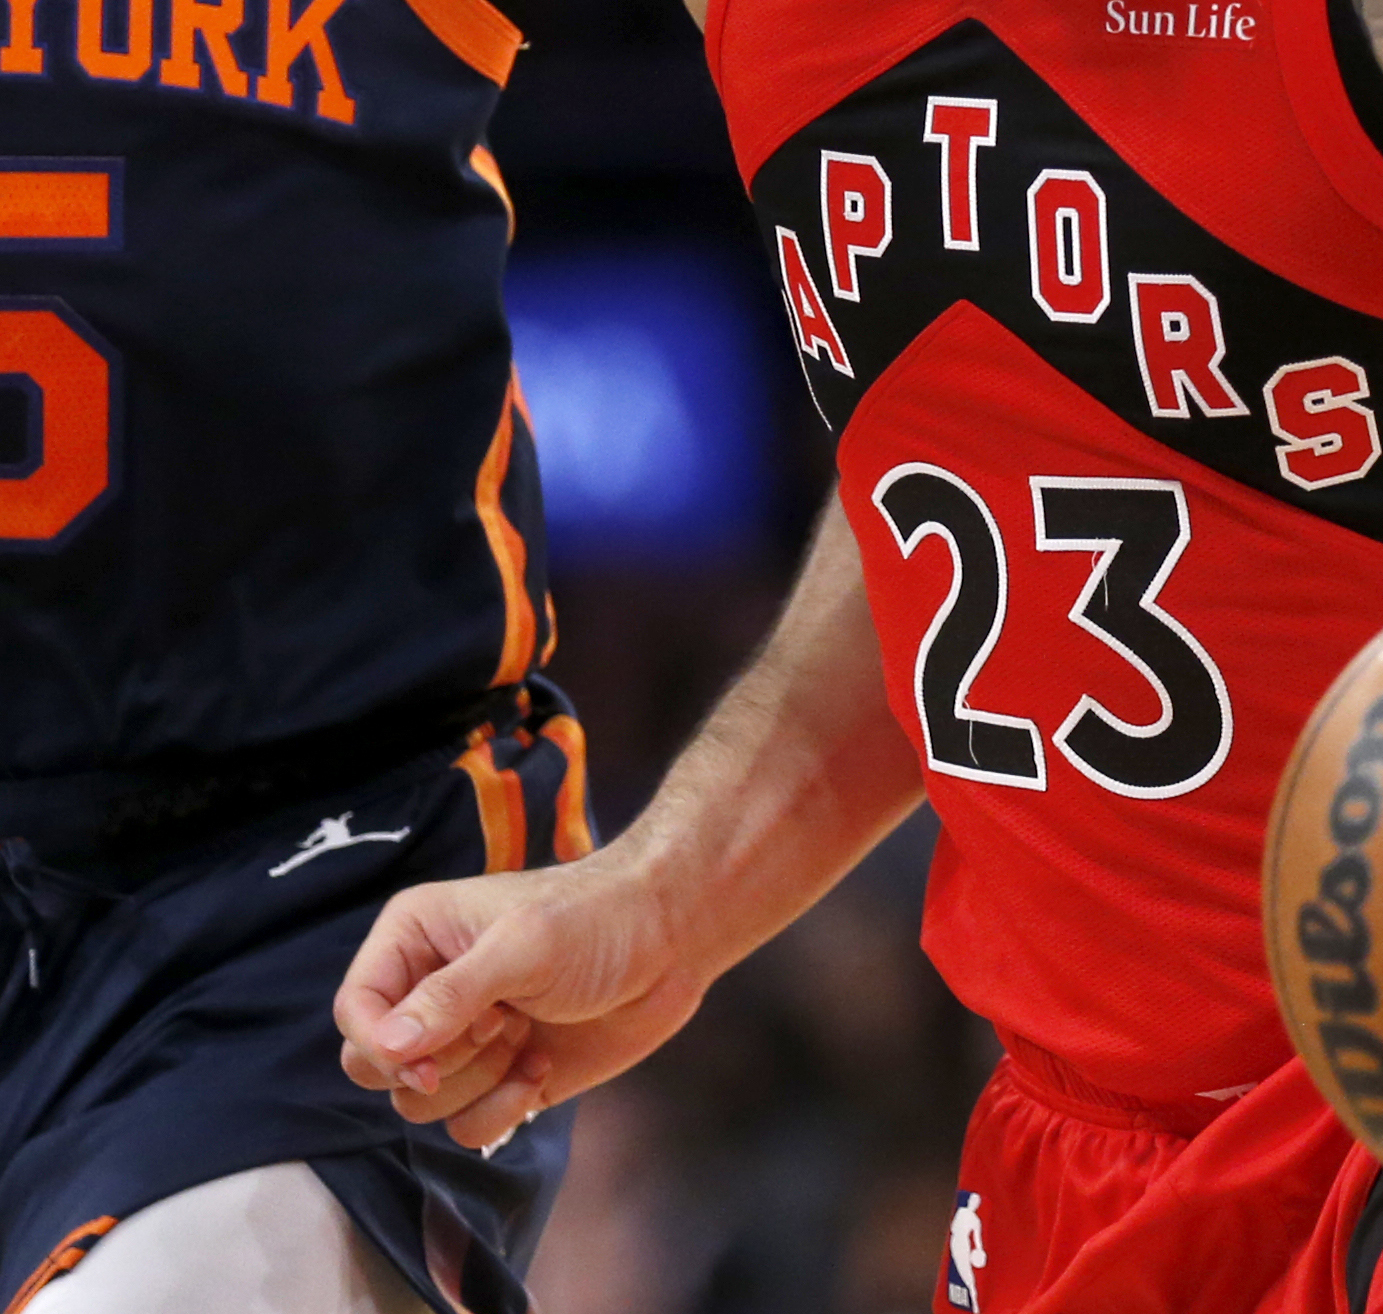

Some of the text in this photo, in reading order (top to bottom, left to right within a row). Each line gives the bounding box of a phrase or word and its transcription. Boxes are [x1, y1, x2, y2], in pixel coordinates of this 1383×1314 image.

[1105, 0, 1257, 42] Sun Life
[775, 95, 1383, 492] APTORS
[871, 461, 1235, 801] 23
